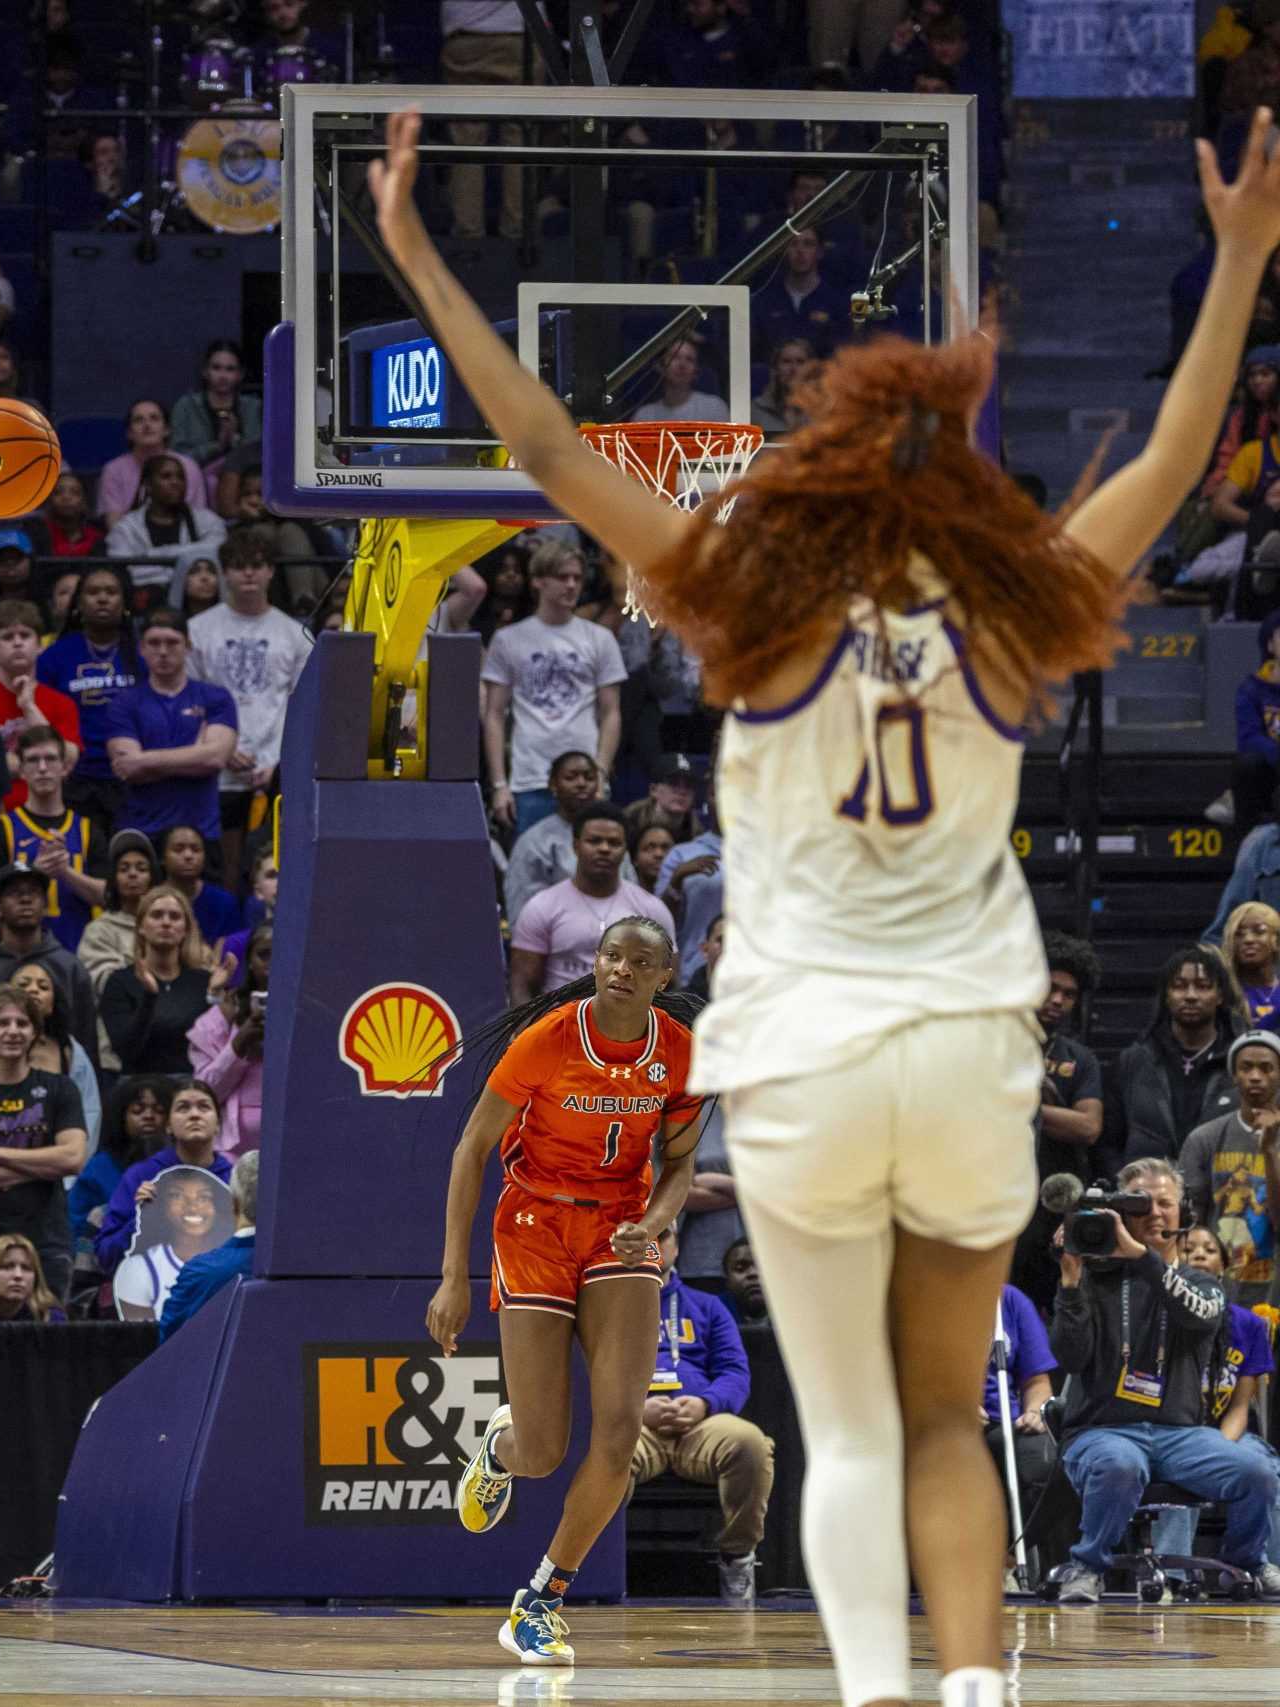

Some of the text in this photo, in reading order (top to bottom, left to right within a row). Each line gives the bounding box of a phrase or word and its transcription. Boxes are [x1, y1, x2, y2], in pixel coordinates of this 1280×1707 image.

[388, 346, 440, 413] KUDO
[315, 472, 384, 488] SPALDING
[1141, 635, 1198, 657] 227
[1010, 831, 1220, 856] 9 120
[646, 1062, 668, 1084] SEC
[560, 1094, 667, 1114] AUBURN
[599, 1121, 623, 1167] 1
[317, 1356, 500, 1466] H&E
